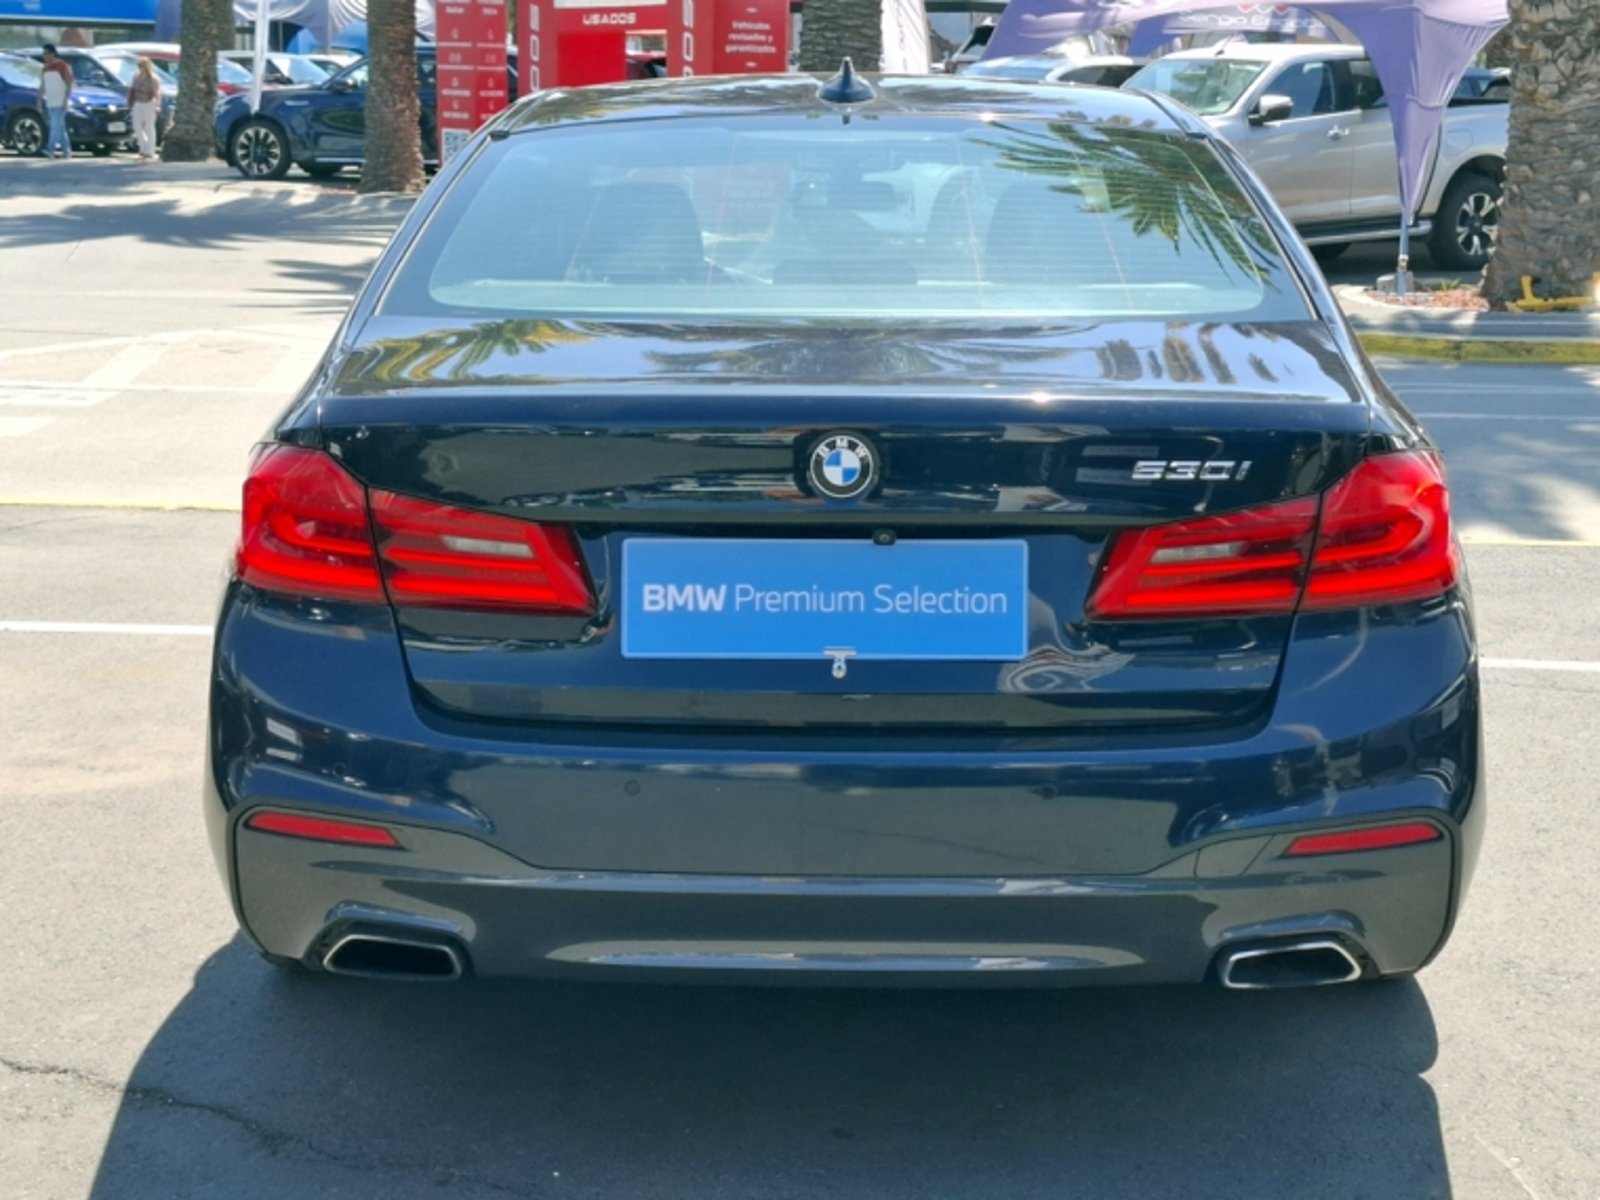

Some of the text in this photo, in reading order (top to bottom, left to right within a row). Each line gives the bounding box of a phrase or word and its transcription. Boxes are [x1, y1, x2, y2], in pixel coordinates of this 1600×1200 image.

[582, 12, 637, 26] USADOS
[818, 436, 869, 459] BMW
[642, 583, 1007, 614] BMW Premium Selection
